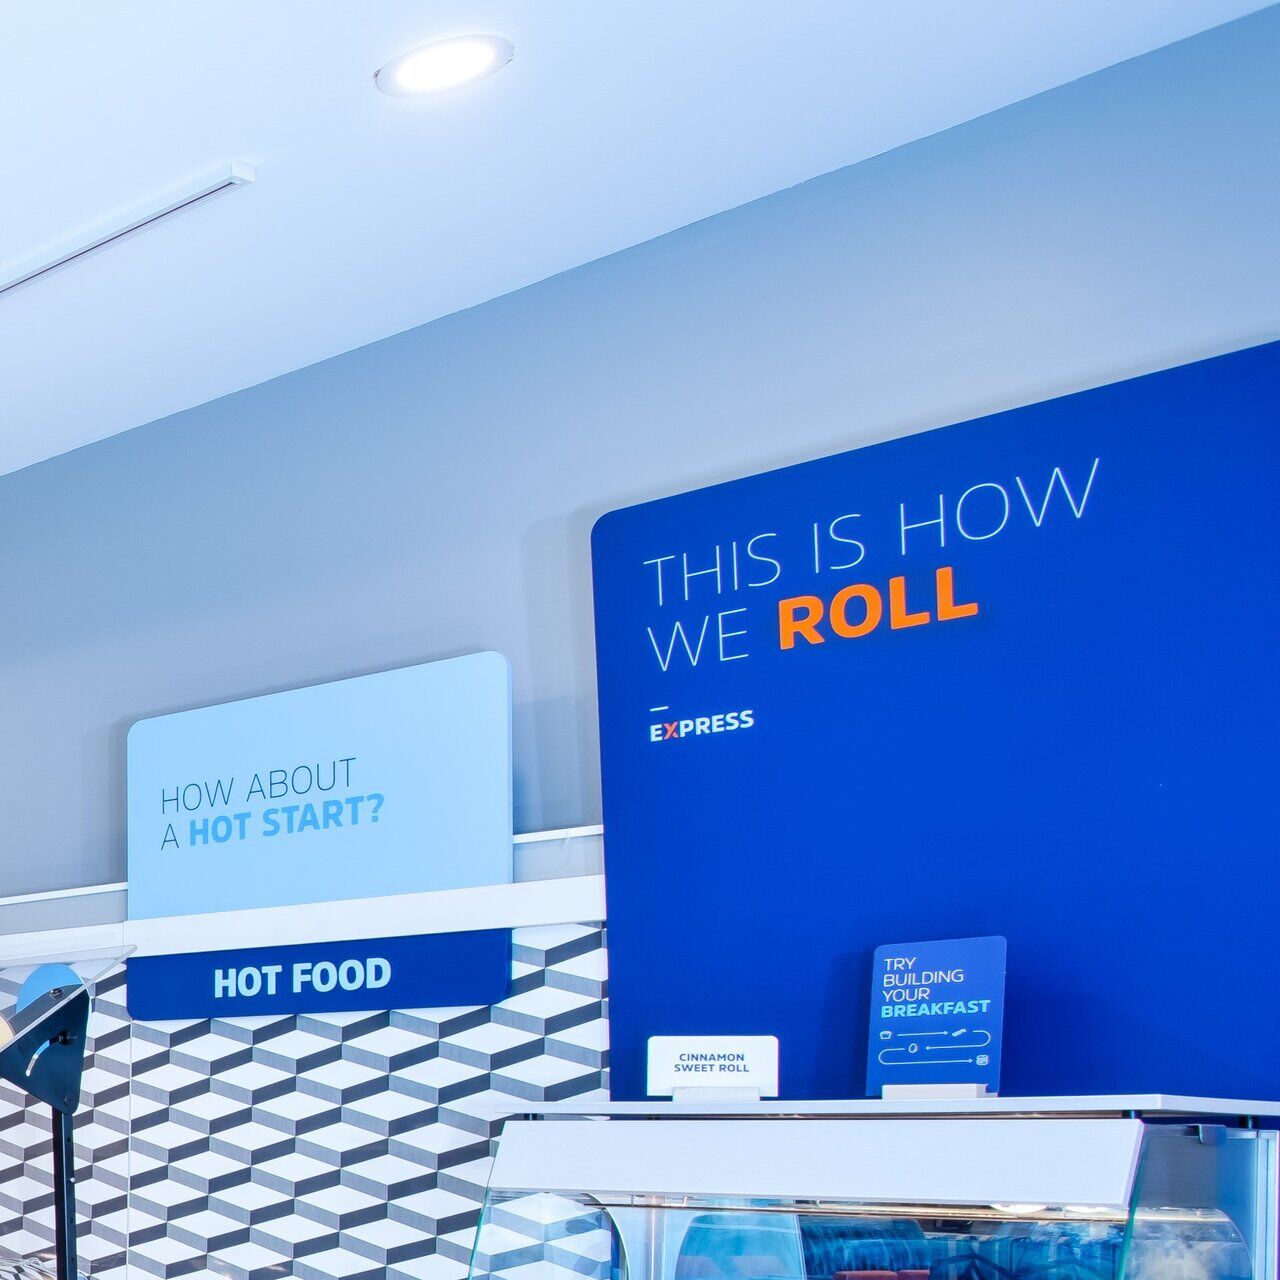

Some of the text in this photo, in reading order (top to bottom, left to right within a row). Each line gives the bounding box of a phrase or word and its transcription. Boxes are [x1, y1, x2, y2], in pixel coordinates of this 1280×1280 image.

[643, 457, 1100, 607] THIS IS HOW
[646, 565, 980, 672] WE ROLL
[649, 708, 755, 743] EXPRESS
[161, 756, 358, 815] HOW ABOUT
[160, 792, 385, 852] A HOT START?
[214, 956, 393, 999] HOT FOOD
[883, 957, 917, 972] TRY
[883, 968, 965, 988] BUILDING
[882, 987, 930, 1003] YOUR
[880, 999, 991, 1019] BREAKFAST
[674, 1063, 750, 1073] SWEET ROLL
[679, 1053, 745, 1062] CINNAMON
